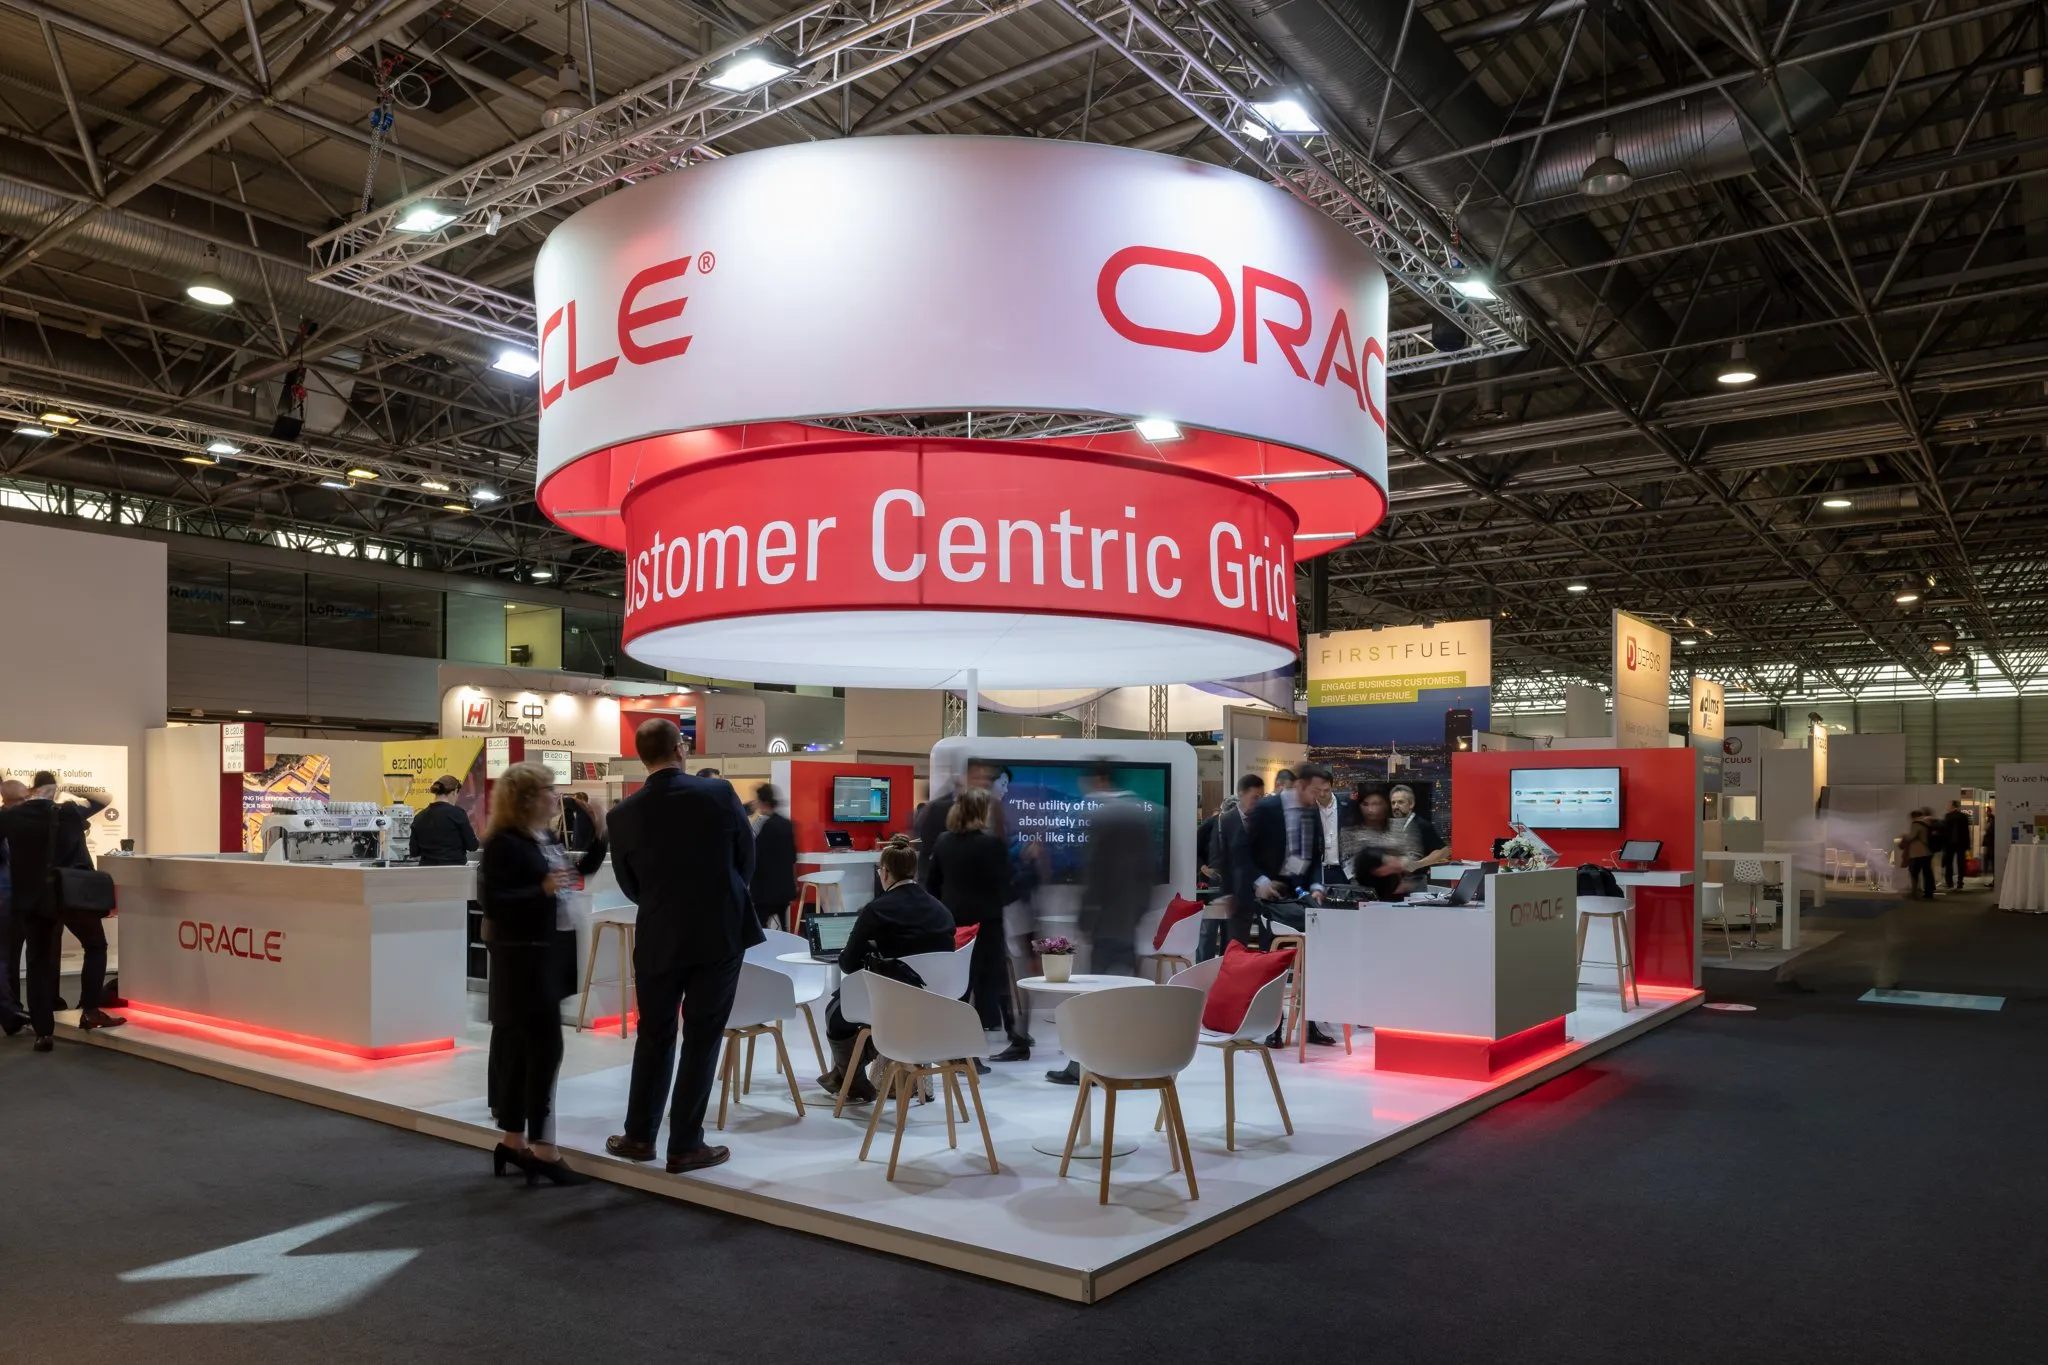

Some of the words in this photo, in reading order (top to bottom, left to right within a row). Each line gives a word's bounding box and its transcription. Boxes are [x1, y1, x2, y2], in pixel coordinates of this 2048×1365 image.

[872, 489, 1182, 599] Centric
[1209, 521, 1289, 622] Grid
[1321, 682, 1357, 691] ENGAGE
[1359, 679, 1402, 688] BUSINESS
[1403, 675, 1462, 686] CUSTOMERS.
[1321, 694, 1346, 703] DRIVE
[1348, 693, 1368, 702] NEW
[1369, 691, 1413, 701] REVENUE.
[498, 699, 544, 721] 汇中
[392, 753, 447, 773] ezzingsolar
[63, 768, 92, 777] solution
[2002, 775, 2020, 783] You
[69, 785, 106, 793] customers
[1038, 800, 1069, 813] utility
[1073, 800, 1085, 811] of
[1144, 801, 1152, 812] is
[1018, 816, 1075, 828] absolutely
[1018, 832, 1042, 842] look
[1045, 832, 1064, 843] like
[1067, 832, 1075, 843] it
